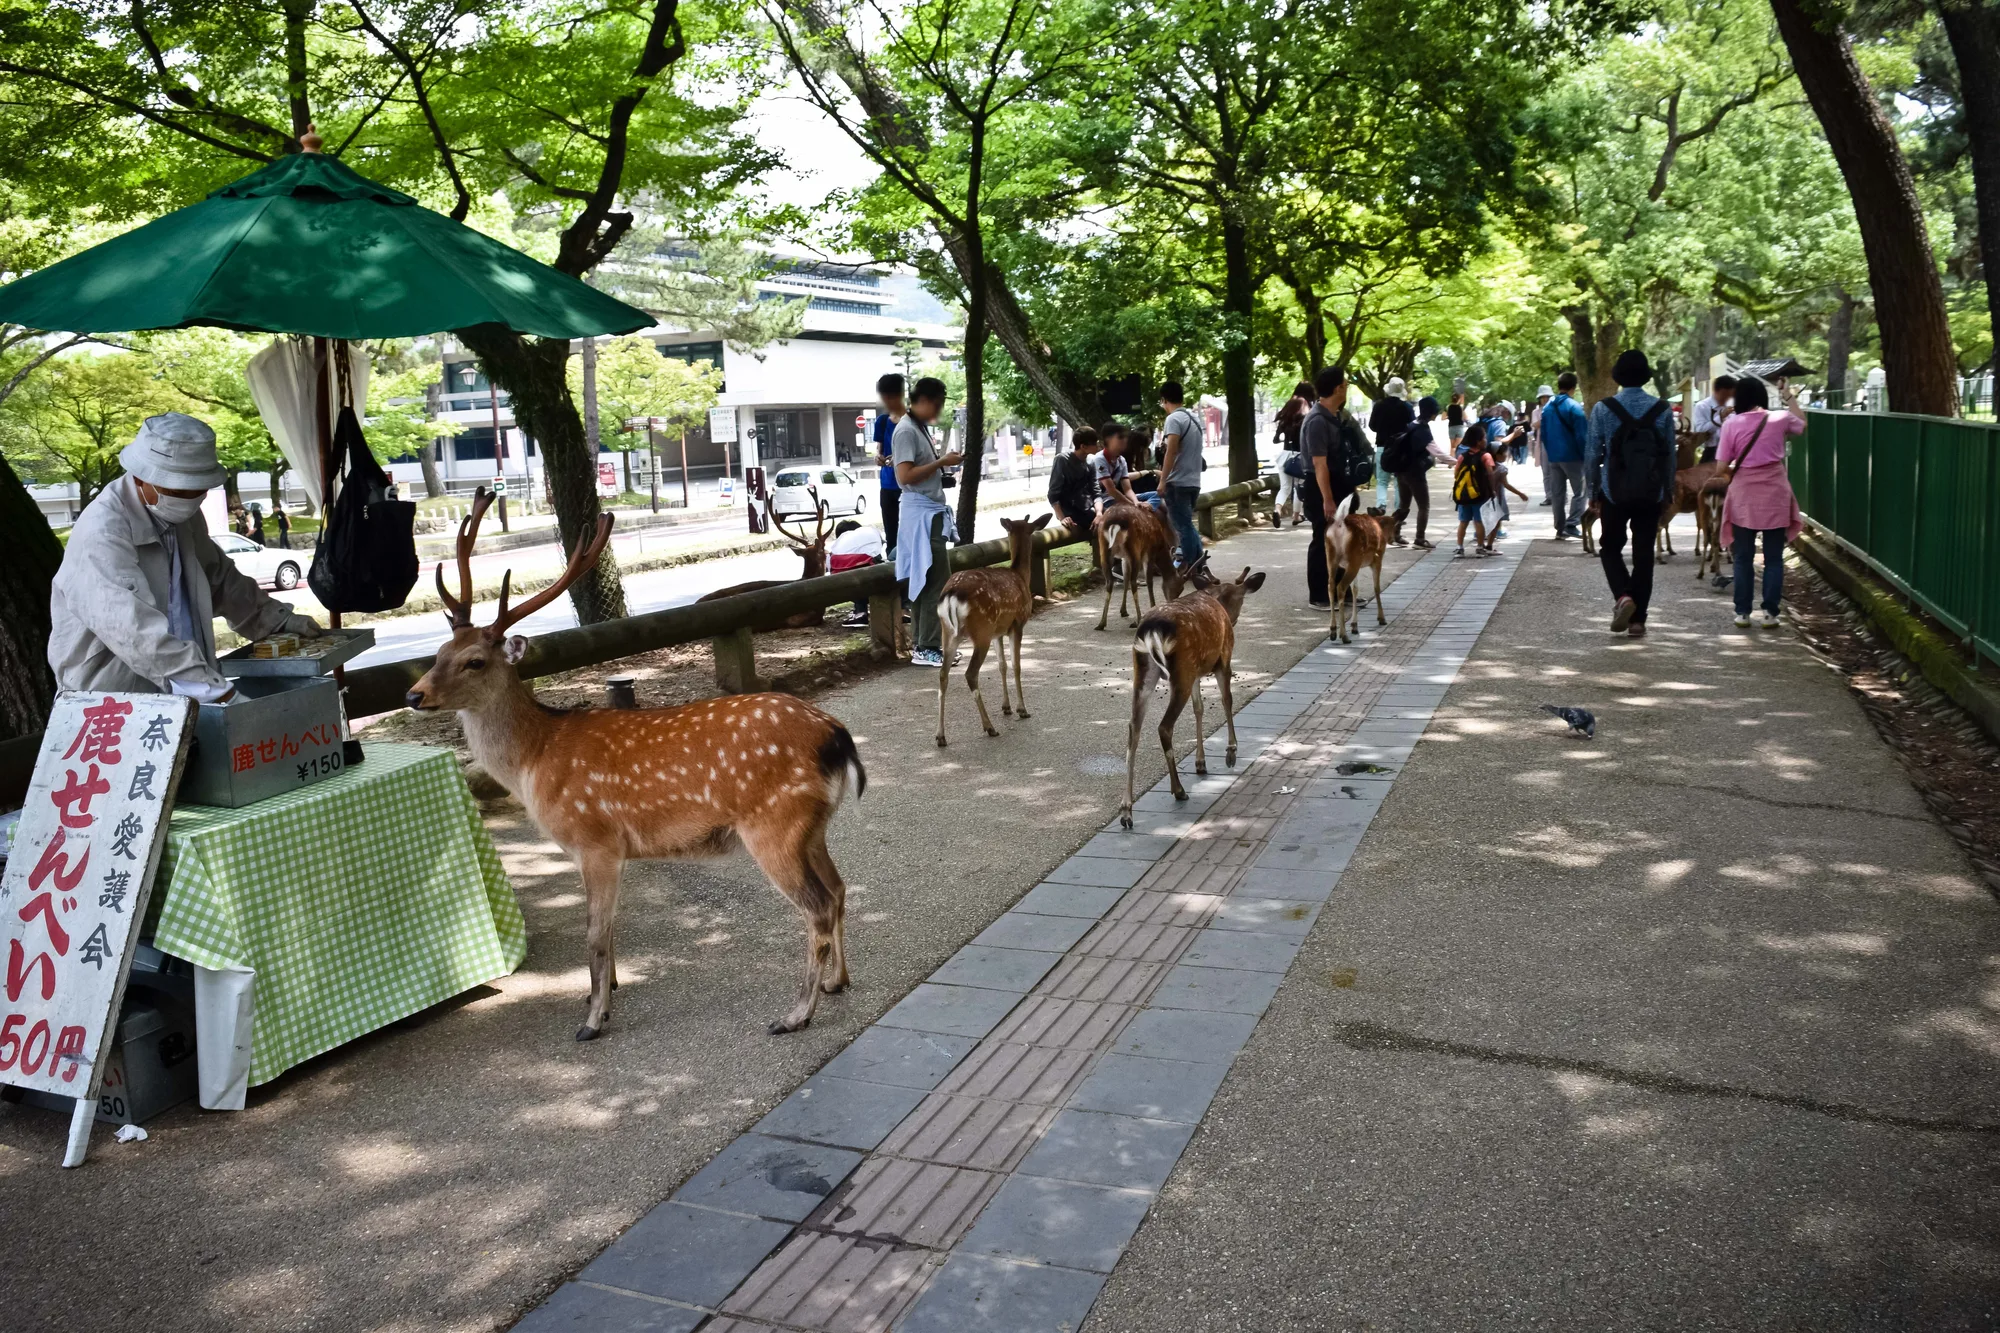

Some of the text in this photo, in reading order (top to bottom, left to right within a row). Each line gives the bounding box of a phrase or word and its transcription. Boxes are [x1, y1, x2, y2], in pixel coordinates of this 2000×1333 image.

[494, 483, 505, 492] P
[233, 724, 339, 773] 鹿せんべい
[297, 751, 340, 781] ¥150
[7, 696, 133, 1002] 鹿せんべい
[79, 714, 173, 971] 奈良愛護会
